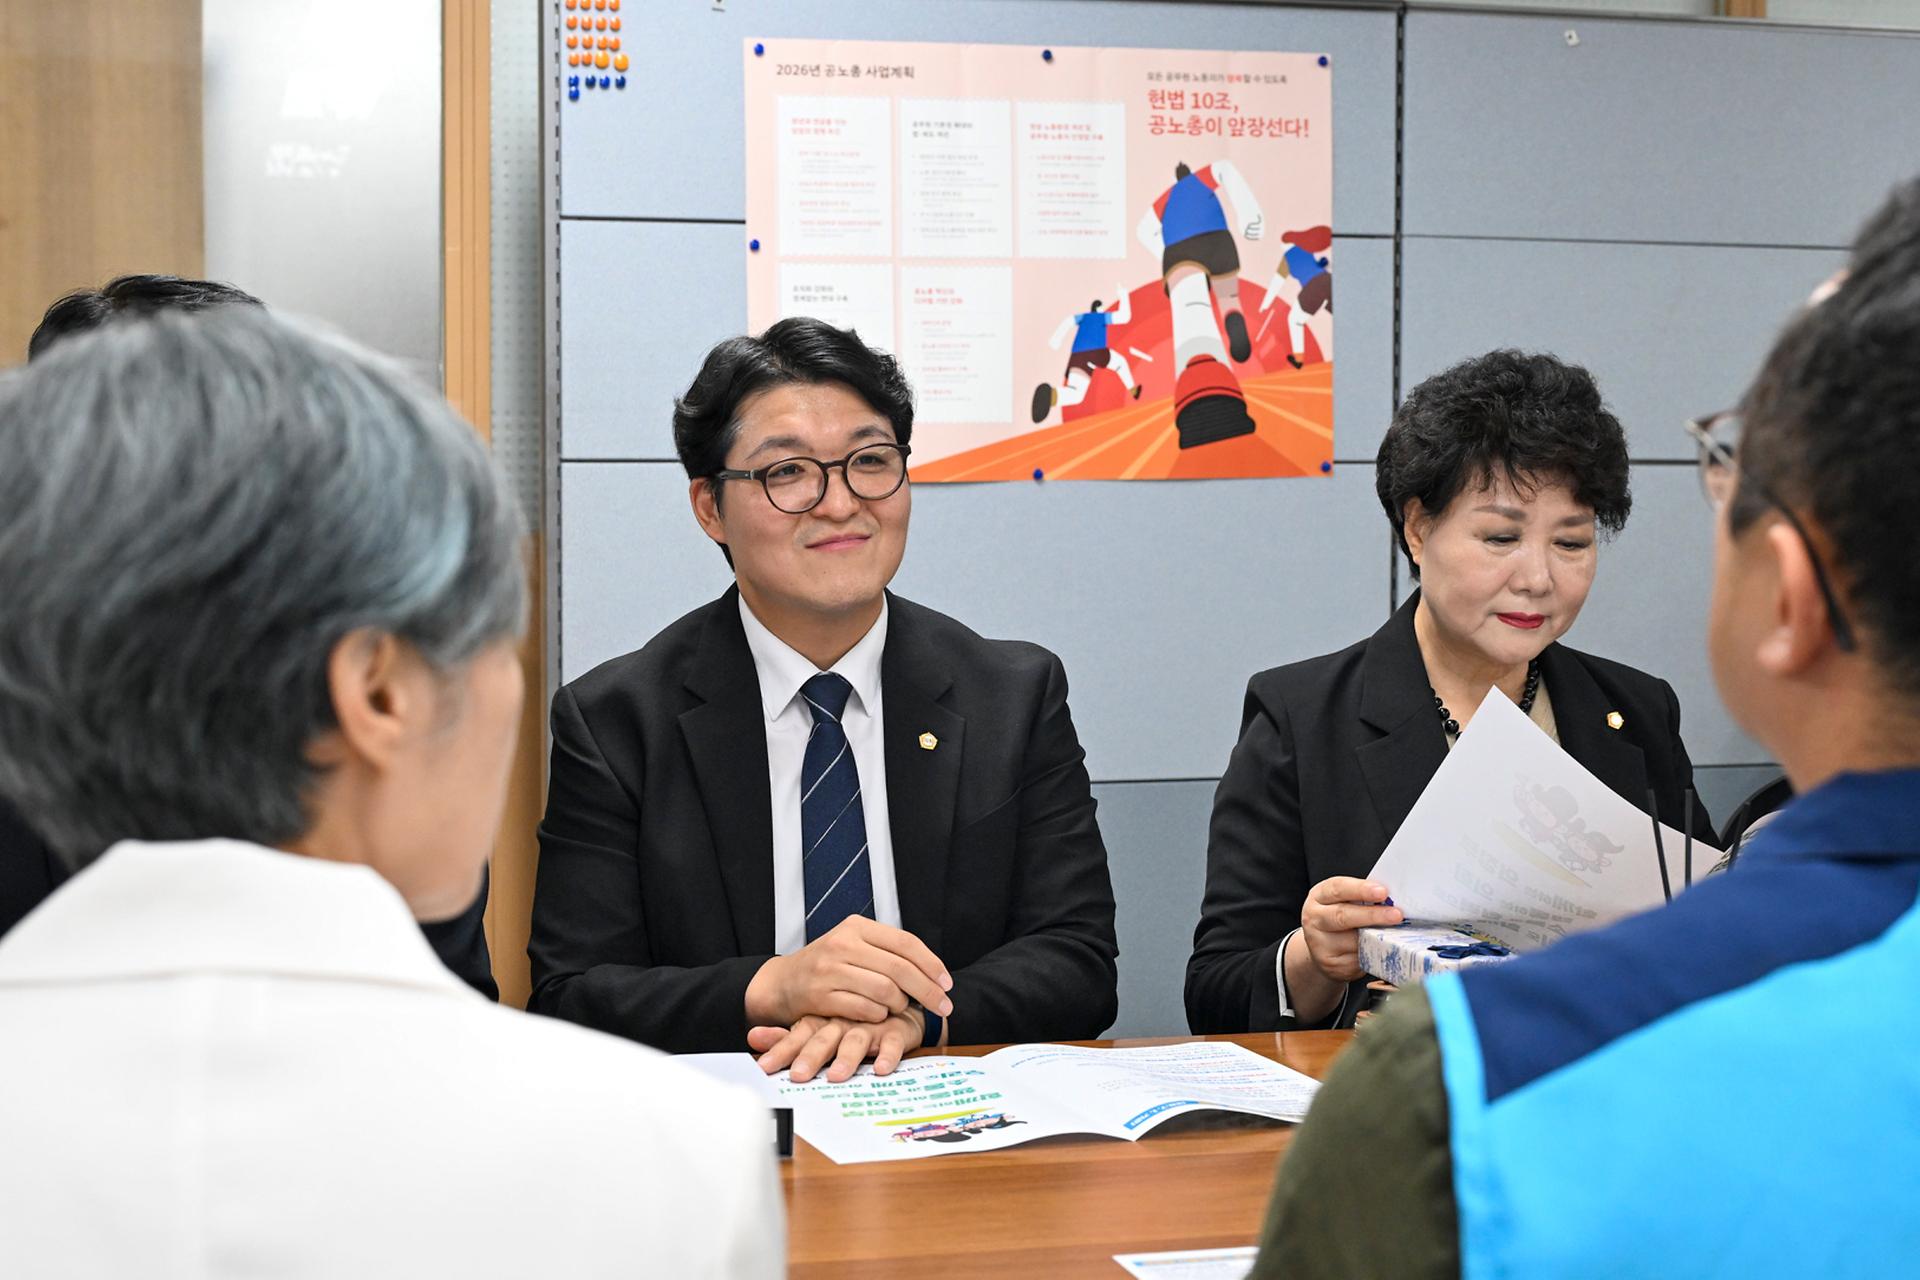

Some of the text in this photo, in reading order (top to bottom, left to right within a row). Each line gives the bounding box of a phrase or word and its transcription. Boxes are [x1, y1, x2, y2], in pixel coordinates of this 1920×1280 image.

[776, 64, 915, 79] 2026년 공노총 사업계획
[1148, 89, 1239, 113] 헌법 10조,
[1148, 115, 1309, 138] 공노총이 앞장선다!
